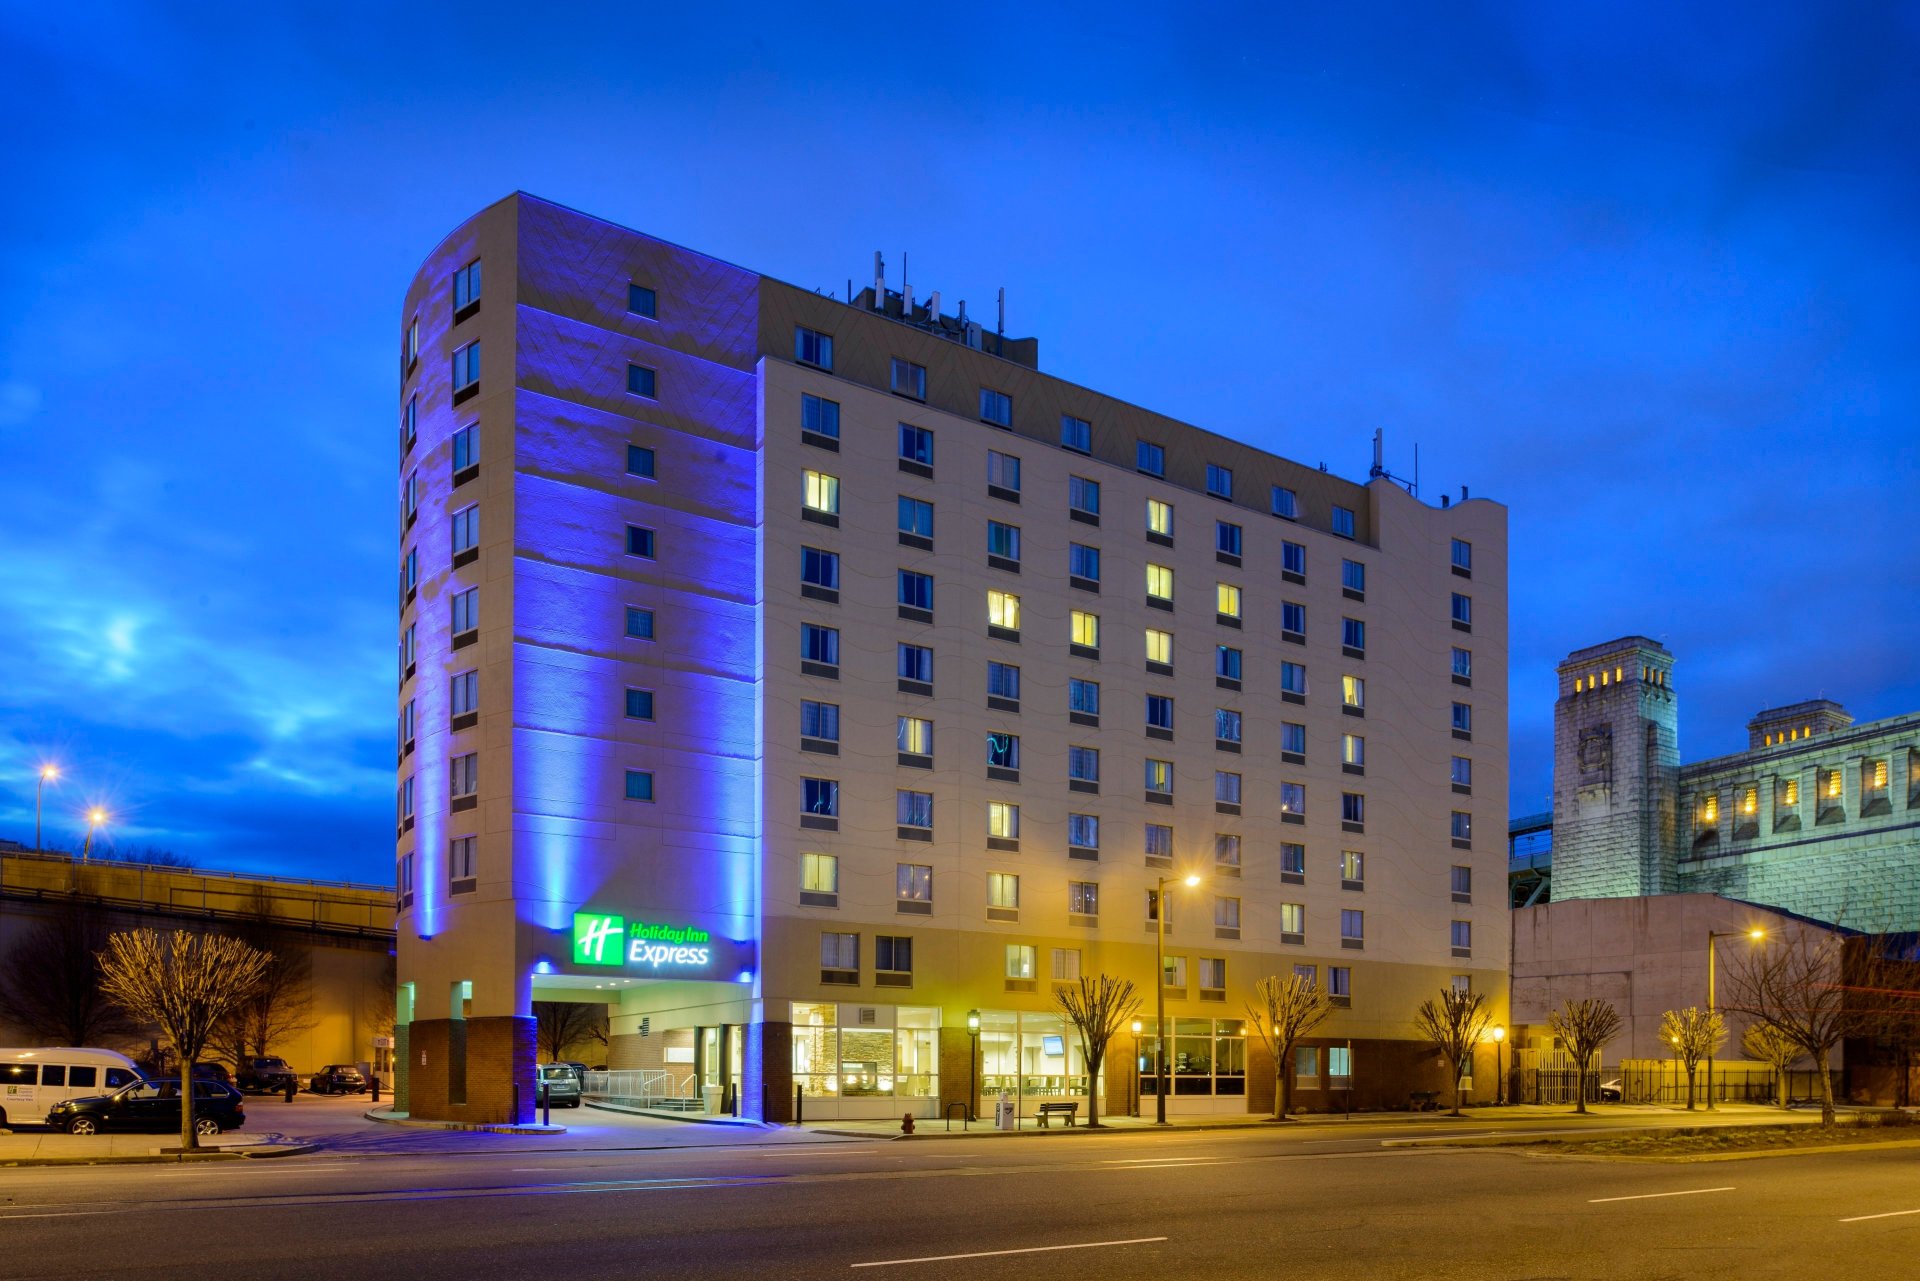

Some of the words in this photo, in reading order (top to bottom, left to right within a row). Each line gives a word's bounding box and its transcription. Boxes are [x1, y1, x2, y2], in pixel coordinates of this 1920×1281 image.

[630, 923, 685, 944] Holiday
[686, 926, 708, 942] Inn
[629, 940, 709, 967] Express
